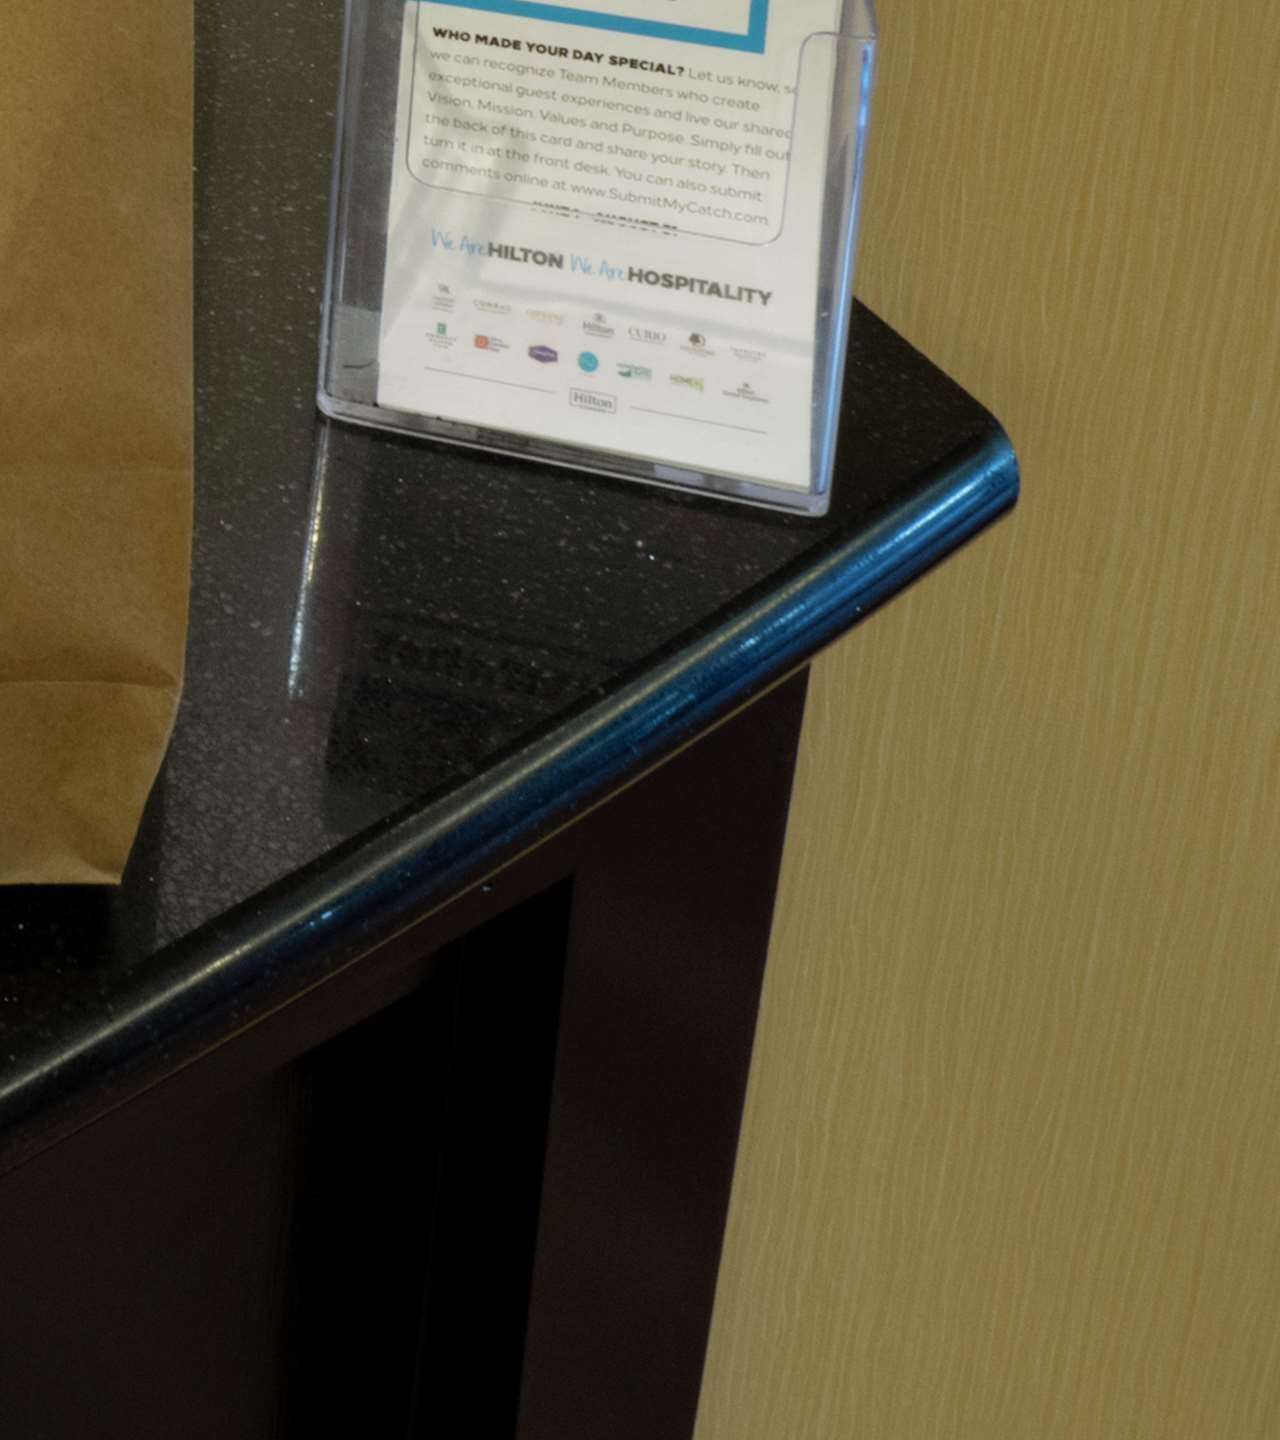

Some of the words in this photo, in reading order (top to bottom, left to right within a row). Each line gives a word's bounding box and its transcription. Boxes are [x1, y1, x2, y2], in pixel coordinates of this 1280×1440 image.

[430, 50, 450, 61] we
[453, 53, 480, 65] can
[482, 58, 556, 78] recognize
[560, 68, 598, 85] Team
[602, 76, 673, 97] Members
[677, 88, 709, 103] who
[712, 95, 760, 111] create
[433, 26, 471, 42] WHO
[475, 34, 522, 50] MADE
[526, 42, 568, 57] YOUR
[573, 49, 604, 65] DAY
[608, 55, 684, 76] SPECIAL?
[689, 68, 713, 81] Let
[717, 74, 733, 85] us
[428, 71, 513, 92] exceptional
[516, 85, 556, 101] guest
[561, 93, 650, 116] experiences
[654, 108, 682, 121] and
[686, 112, 710, 126] live
[714, 118, 738, 130] our
[425, 113, 450, 127] the
[453, 117, 488, 133] back
[491, 123, 506, 136] of
[509, 126, 536, 142] this
[539, 132, 573, 148] card
[576, 138, 603, 153] and
[607, 144, 648, 160] share
[651, 151, 683, 167] your
[731, 163, 770, 181] Then
[539, 109, 587, 128] Values
[589, 118, 618, 133] and
[690, 134, 741, 155] Simply
[744, 143, 763, 157] fill
[421, 157, 501, 181] comments
[504, 169, 549, 188] online
[551, 178, 566, 191] at
[424, 135, 454, 150] turn
[457, 139, 467, 152] it
[471, 142, 484, 155] in
[486, 146, 502, 157] at
[505, 147, 530, 161] the
[533, 152, 570, 170] front
[615, 166, 642, 182] You
[646, 173, 673, 187] can
[676, 177, 707, 193] also
[710, 182, 763, 202] submit
[489, 241, 564, 269] HILTON
[628, 266, 773, 306] HOSPITALITY
[573, 391, 613, 409] Hilton
